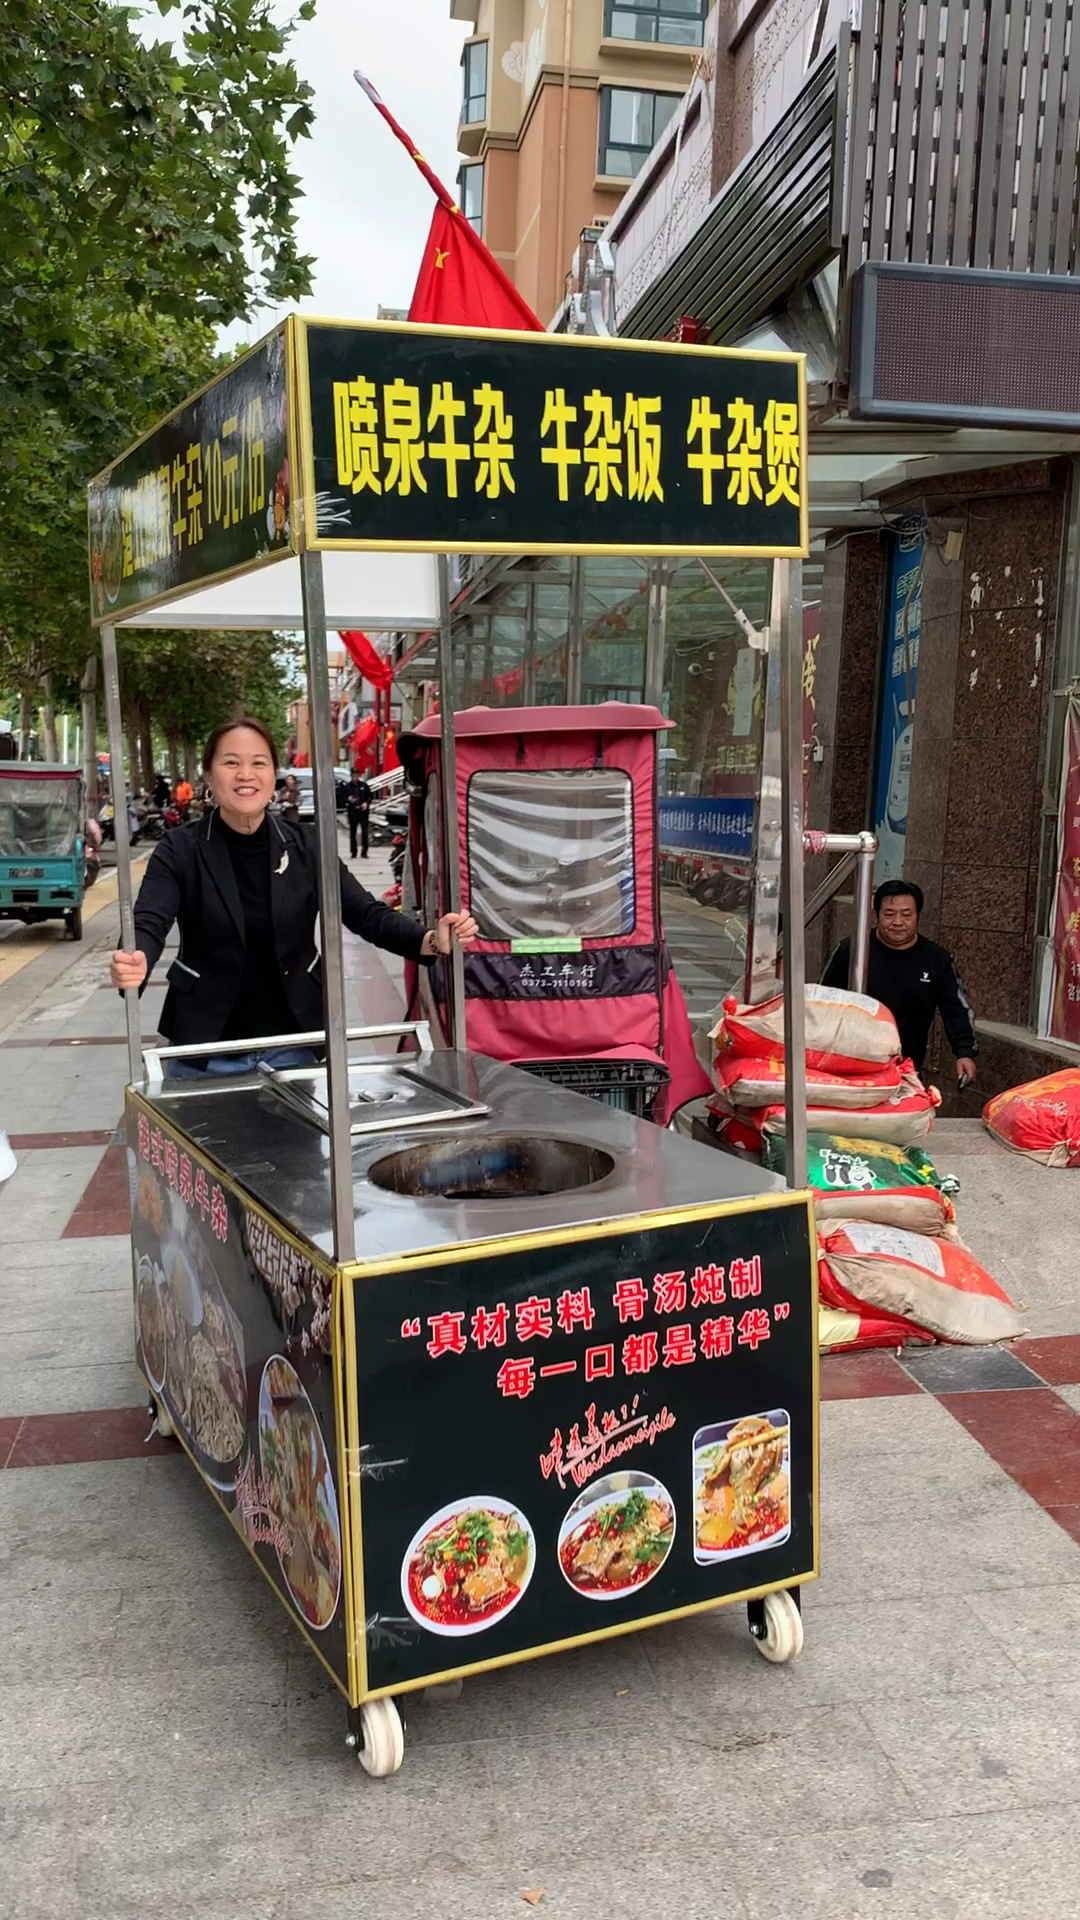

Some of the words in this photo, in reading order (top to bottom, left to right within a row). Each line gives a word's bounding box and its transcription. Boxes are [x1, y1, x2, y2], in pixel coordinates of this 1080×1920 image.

[332, 375, 516, 500] 喷泉牛杂
[540, 387, 664, 504] 牛杂饭
[686, 396, 801, 507] 牛杂煲
[519, 962, 596, 979] 杰工车行
[400, 1285, 596, 1358] “真材实料
[612, 1255, 764, 1325] 骨汤炖制
[497, 1302, 791, 1400] 每一口都是精华”
